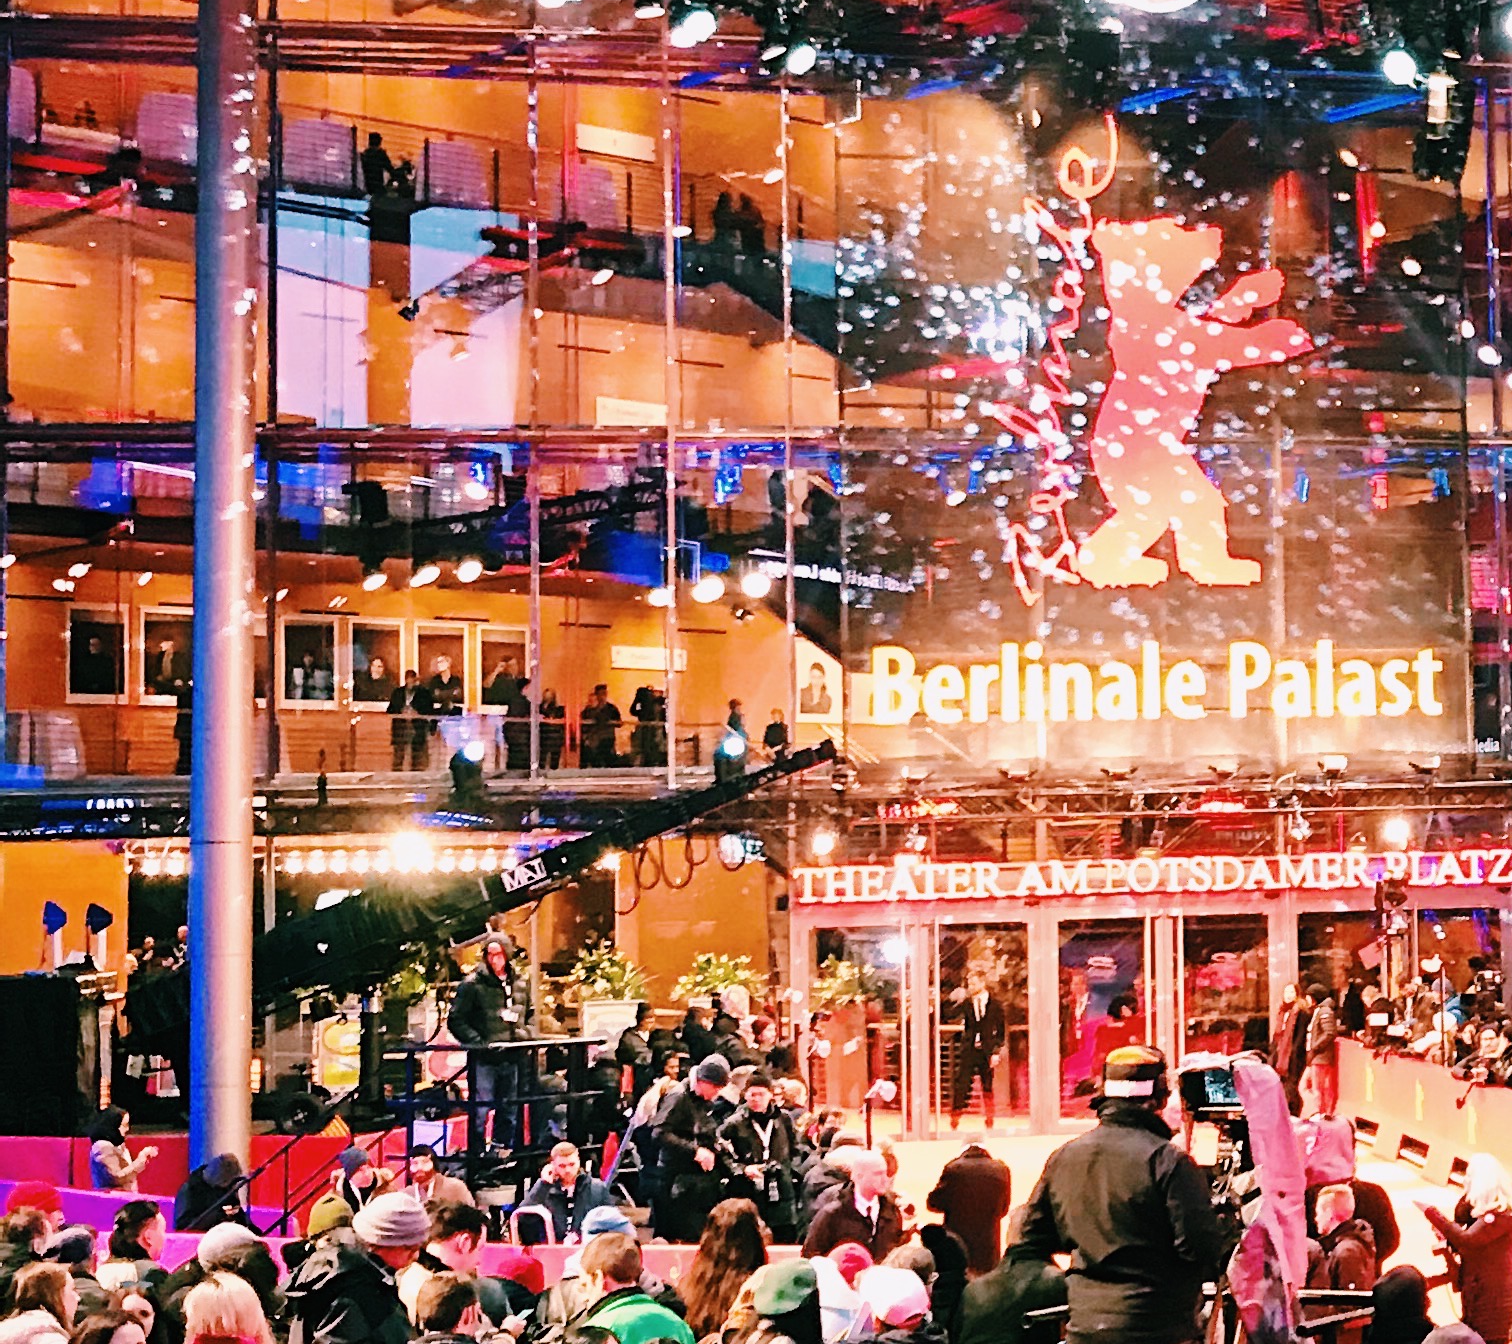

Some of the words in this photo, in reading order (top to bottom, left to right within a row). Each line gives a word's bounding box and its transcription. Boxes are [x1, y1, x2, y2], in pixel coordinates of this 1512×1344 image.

[872, 641, 1205, 724] Berlinale
[1228, 640, 1443, 720] Palast
[793, 859, 1008, 903] THEATER
[1010, 859, 1094, 896] AM
[1101, 853, 1375, 893] POTSDAMER
